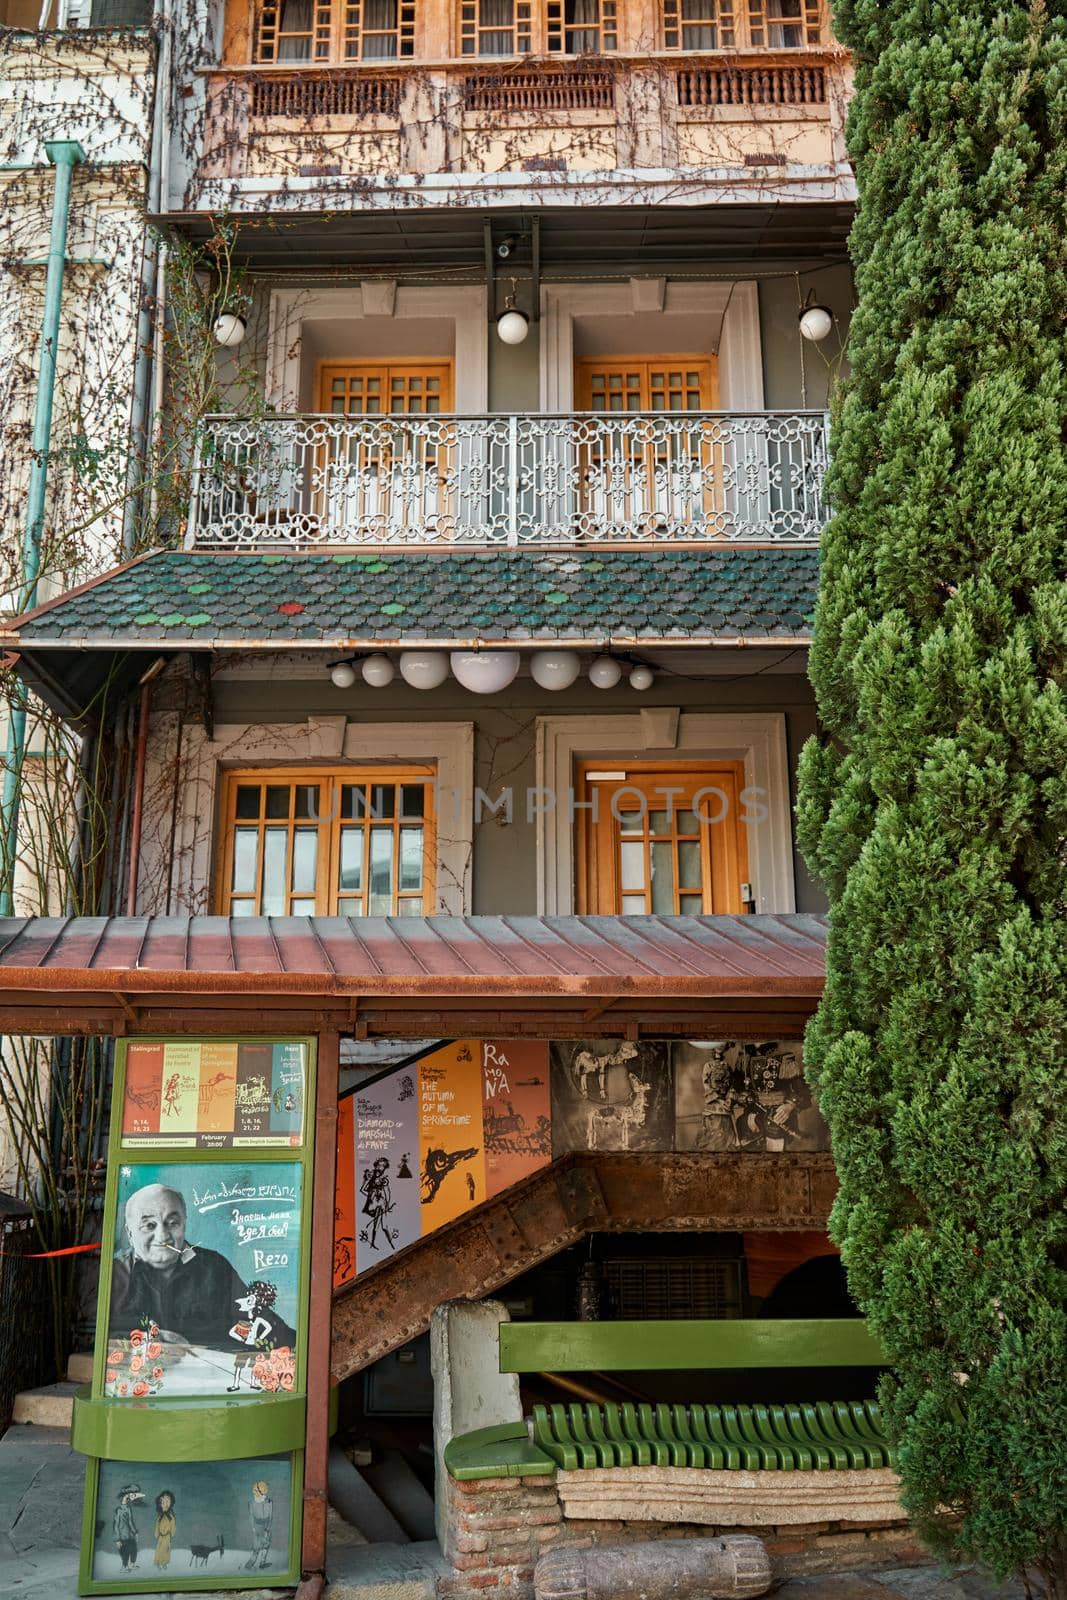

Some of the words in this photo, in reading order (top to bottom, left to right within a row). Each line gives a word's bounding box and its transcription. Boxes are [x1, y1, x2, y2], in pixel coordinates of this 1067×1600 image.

[421, 1081, 438, 1091] THE
[422, 1103, 436, 1112] OF
[201, 1134, 227, 1143] February
[253, 1249, 289, 1269] Rezo
